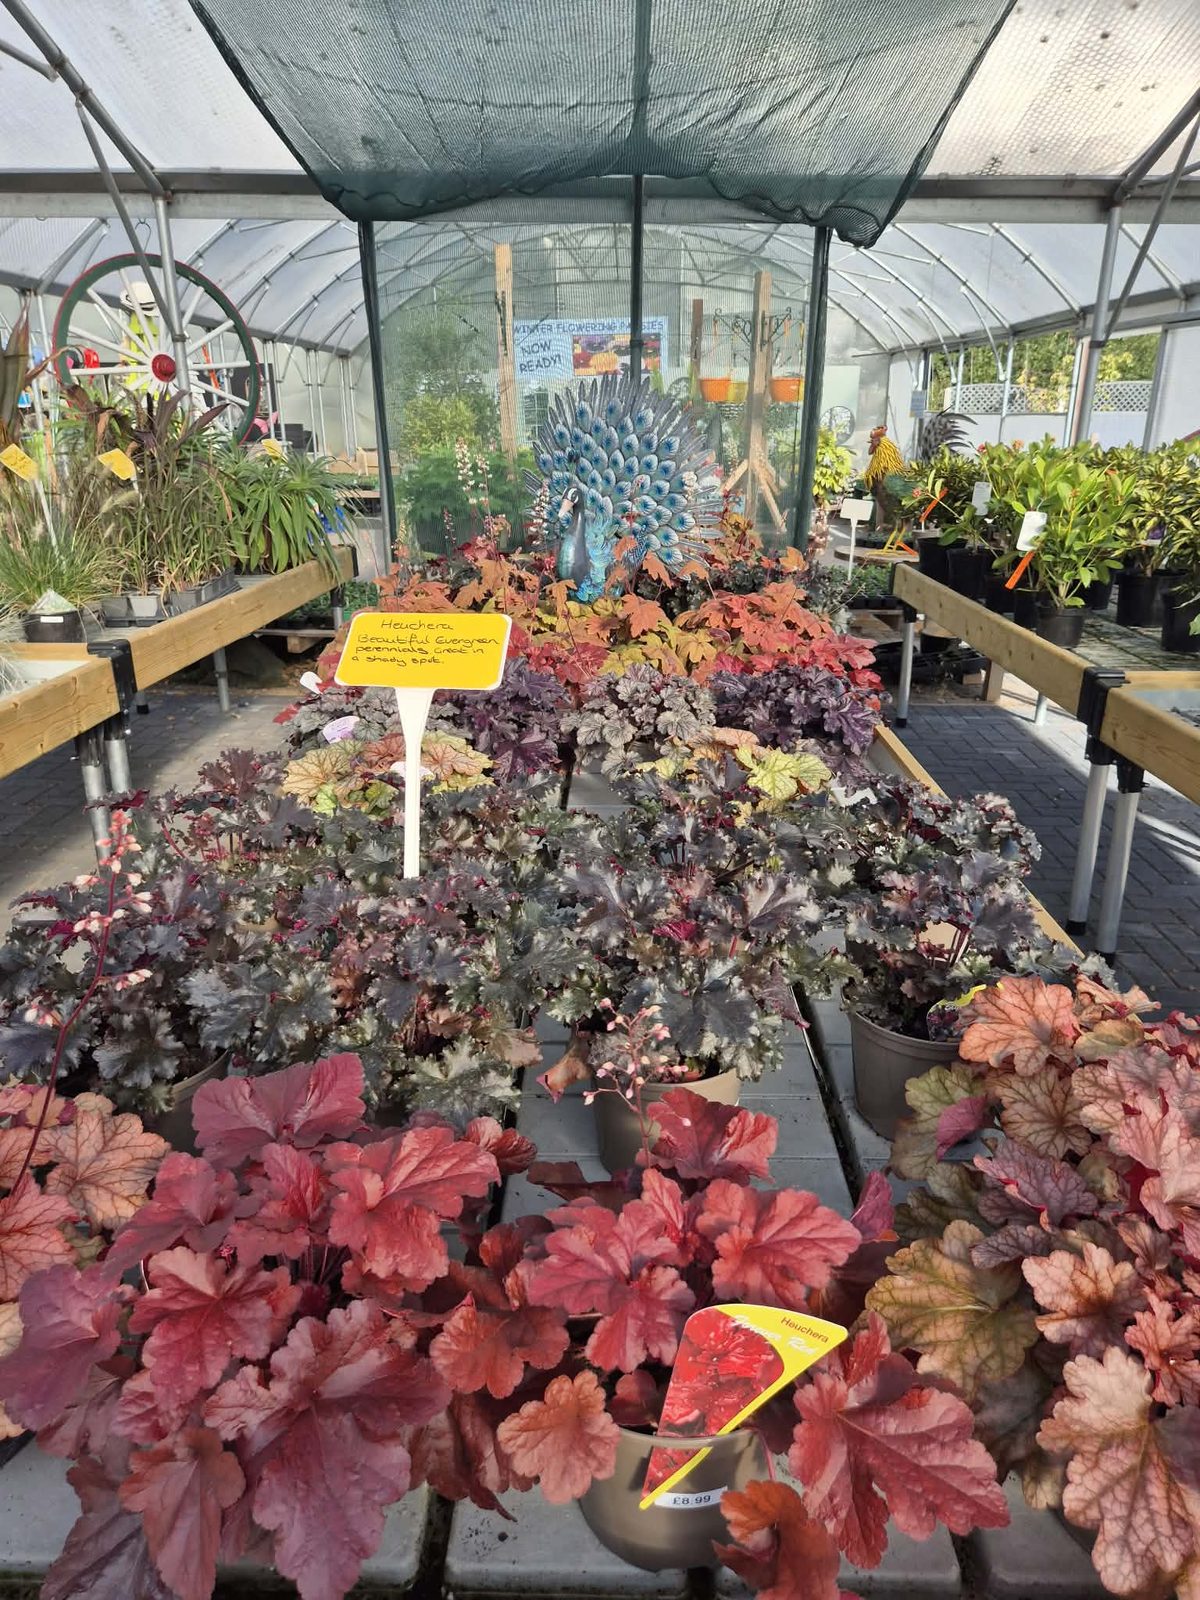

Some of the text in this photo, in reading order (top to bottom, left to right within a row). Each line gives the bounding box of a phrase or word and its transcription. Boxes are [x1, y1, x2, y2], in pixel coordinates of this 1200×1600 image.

[513, 323, 553, 334] WINTER
[556, 320, 617, 333] FLOWERING
[520, 339, 552, 356] NOW
[381, 619, 454, 630] Heuchera
[358, 633, 500, 648] Beautiful Evergreen
[366, 655, 407, 667] shady
[780, 1316, 829, 1344] Heuchera
[673, 1495, 711, 1505] £8.99
